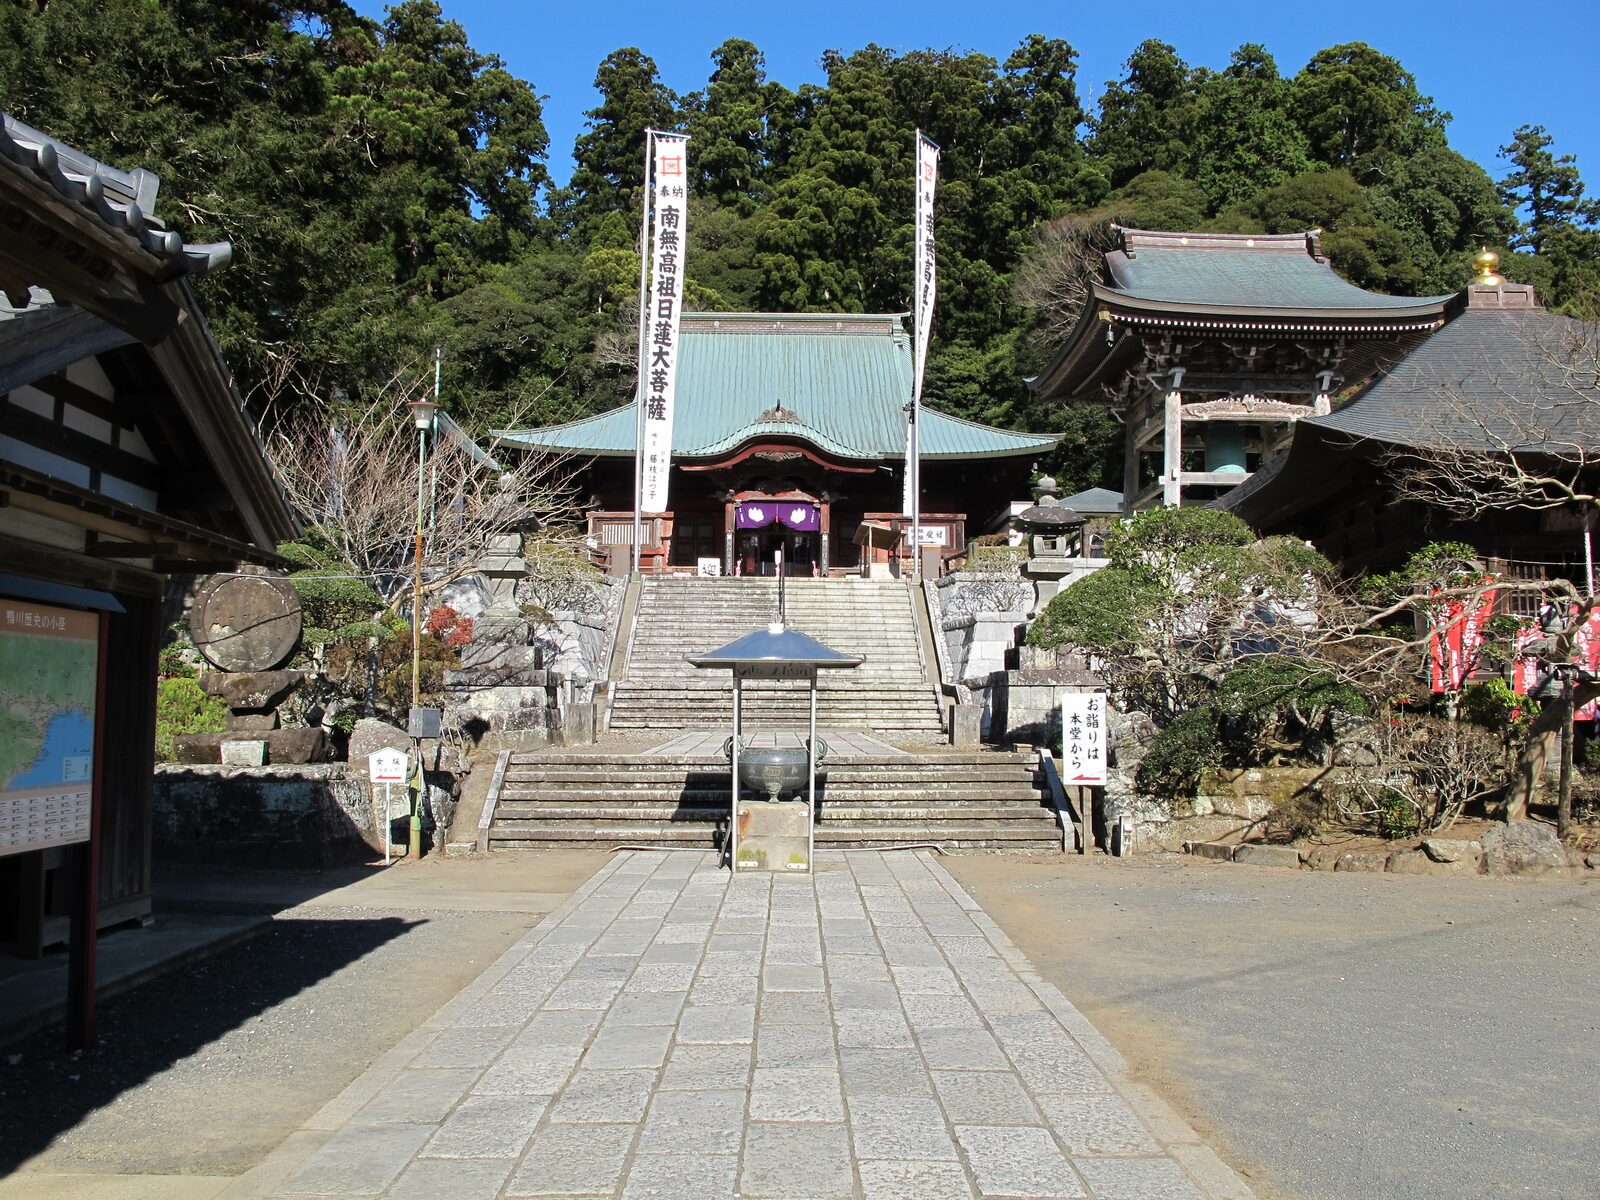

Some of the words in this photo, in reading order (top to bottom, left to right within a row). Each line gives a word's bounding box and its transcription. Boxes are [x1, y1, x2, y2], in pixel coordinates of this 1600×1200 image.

[660, 185, 684, 198] 奉納
[647, 205, 680, 421] 南無高祖日蓮大菩薩
[1069, 712, 1083, 769] 本堂から
[1086, 697, 1099, 760] お詣りは
